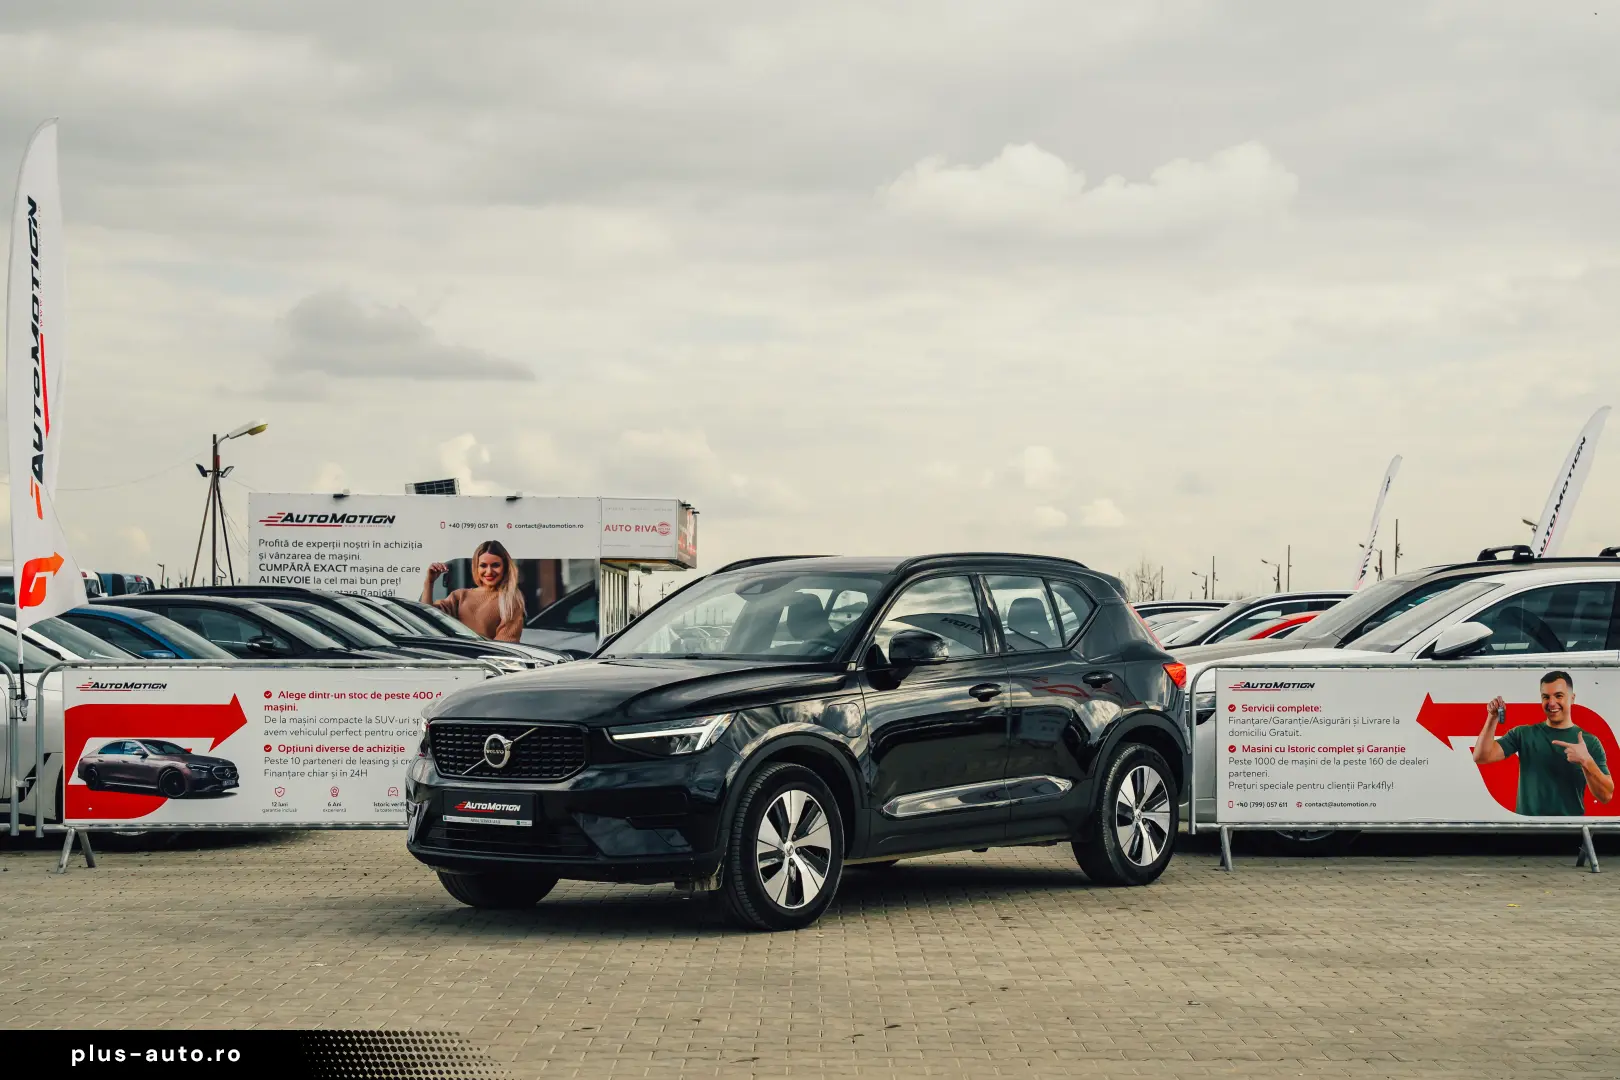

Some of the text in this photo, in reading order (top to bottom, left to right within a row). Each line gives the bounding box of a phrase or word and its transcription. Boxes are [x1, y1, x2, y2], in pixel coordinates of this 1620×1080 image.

[27, 195, 44, 485] AUTOMOTION
[281, 512, 396, 524] AUTOMOTION
[258, 539, 290, 548] Profită
[306, 541, 340, 550] experții
[344, 541, 370, 550] noștri
[384, 541, 423, 550] achiziția
[258, 552, 362, 562] și vânzarea de mașini.
[259, 563, 310, 572] CUMPĂRĂ
[350, 566, 384, 574] mașina
[272, 576, 310, 584] NEVOIE
[381, 578, 401, 587] preț!
[91, 682, 167, 690] AUTOMOTION
[278, 690, 306, 700] Alege
[309, 691, 346, 700] dintr-un
[370, 691, 382, 700] de
[384, 692, 410, 700] peste
[412, 692, 434, 700] 400
[264, 703, 298, 712] mașini.
[1242, 704, 1322, 714] Servicii complete:
[264, 716, 277, 724] De
[280, 716, 287, 724] la
[289, 716, 316, 726] mașini
[319, 716, 362, 726] compacte
[365, 716, 372, 724] la
[374, 716, 410, 724] SUV-uri
[1354, 718, 1360, 726] și
[1362, 717, 1390, 725] Livrare
[1393, 717, 1400, 725] la
[289, 728, 328, 736] vehiculul
[330, 728, 362, 738] perfect
[364, 730, 394, 738] pentru
[1228, 728, 1302, 736] domiciliu Gratuit.
[278, 744, 405, 754] Opțiuni diverse de achiziție
[1288, 744, 1315, 752] Istoric
[1318, 744, 1354, 755] complet
[1357, 745, 1364, 755] și
[1366, 744, 1406, 754] Garanție
[302, 758, 344, 766] parteneri
[359, 757, 390, 767] leasing
[392, 758, 398, 767] și
[1228, 757, 1252, 765] Peste
[1255, 757, 1276, 765] 1000
[1278, 757, 1288, 765] de
[1292, 758, 1318, 767] mașini
[1320, 757, 1332, 765] de
[1334, 757, 1340, 765] la
[1344, 758, 1366, 767] peste
[1386, 757, 1397, 765] de
[1400, 758, 1428, 766] dealeri
[264, 770, 306, 779] Finanțare
[331, 770, 338, 779] și
[1228, 770, 1270, 778] parteneri.
[1228, 782, 1394, 792] Prețuri speciale pentru clienții Park4fly!
[464, 802, 521, 812] AUTOMOTION
